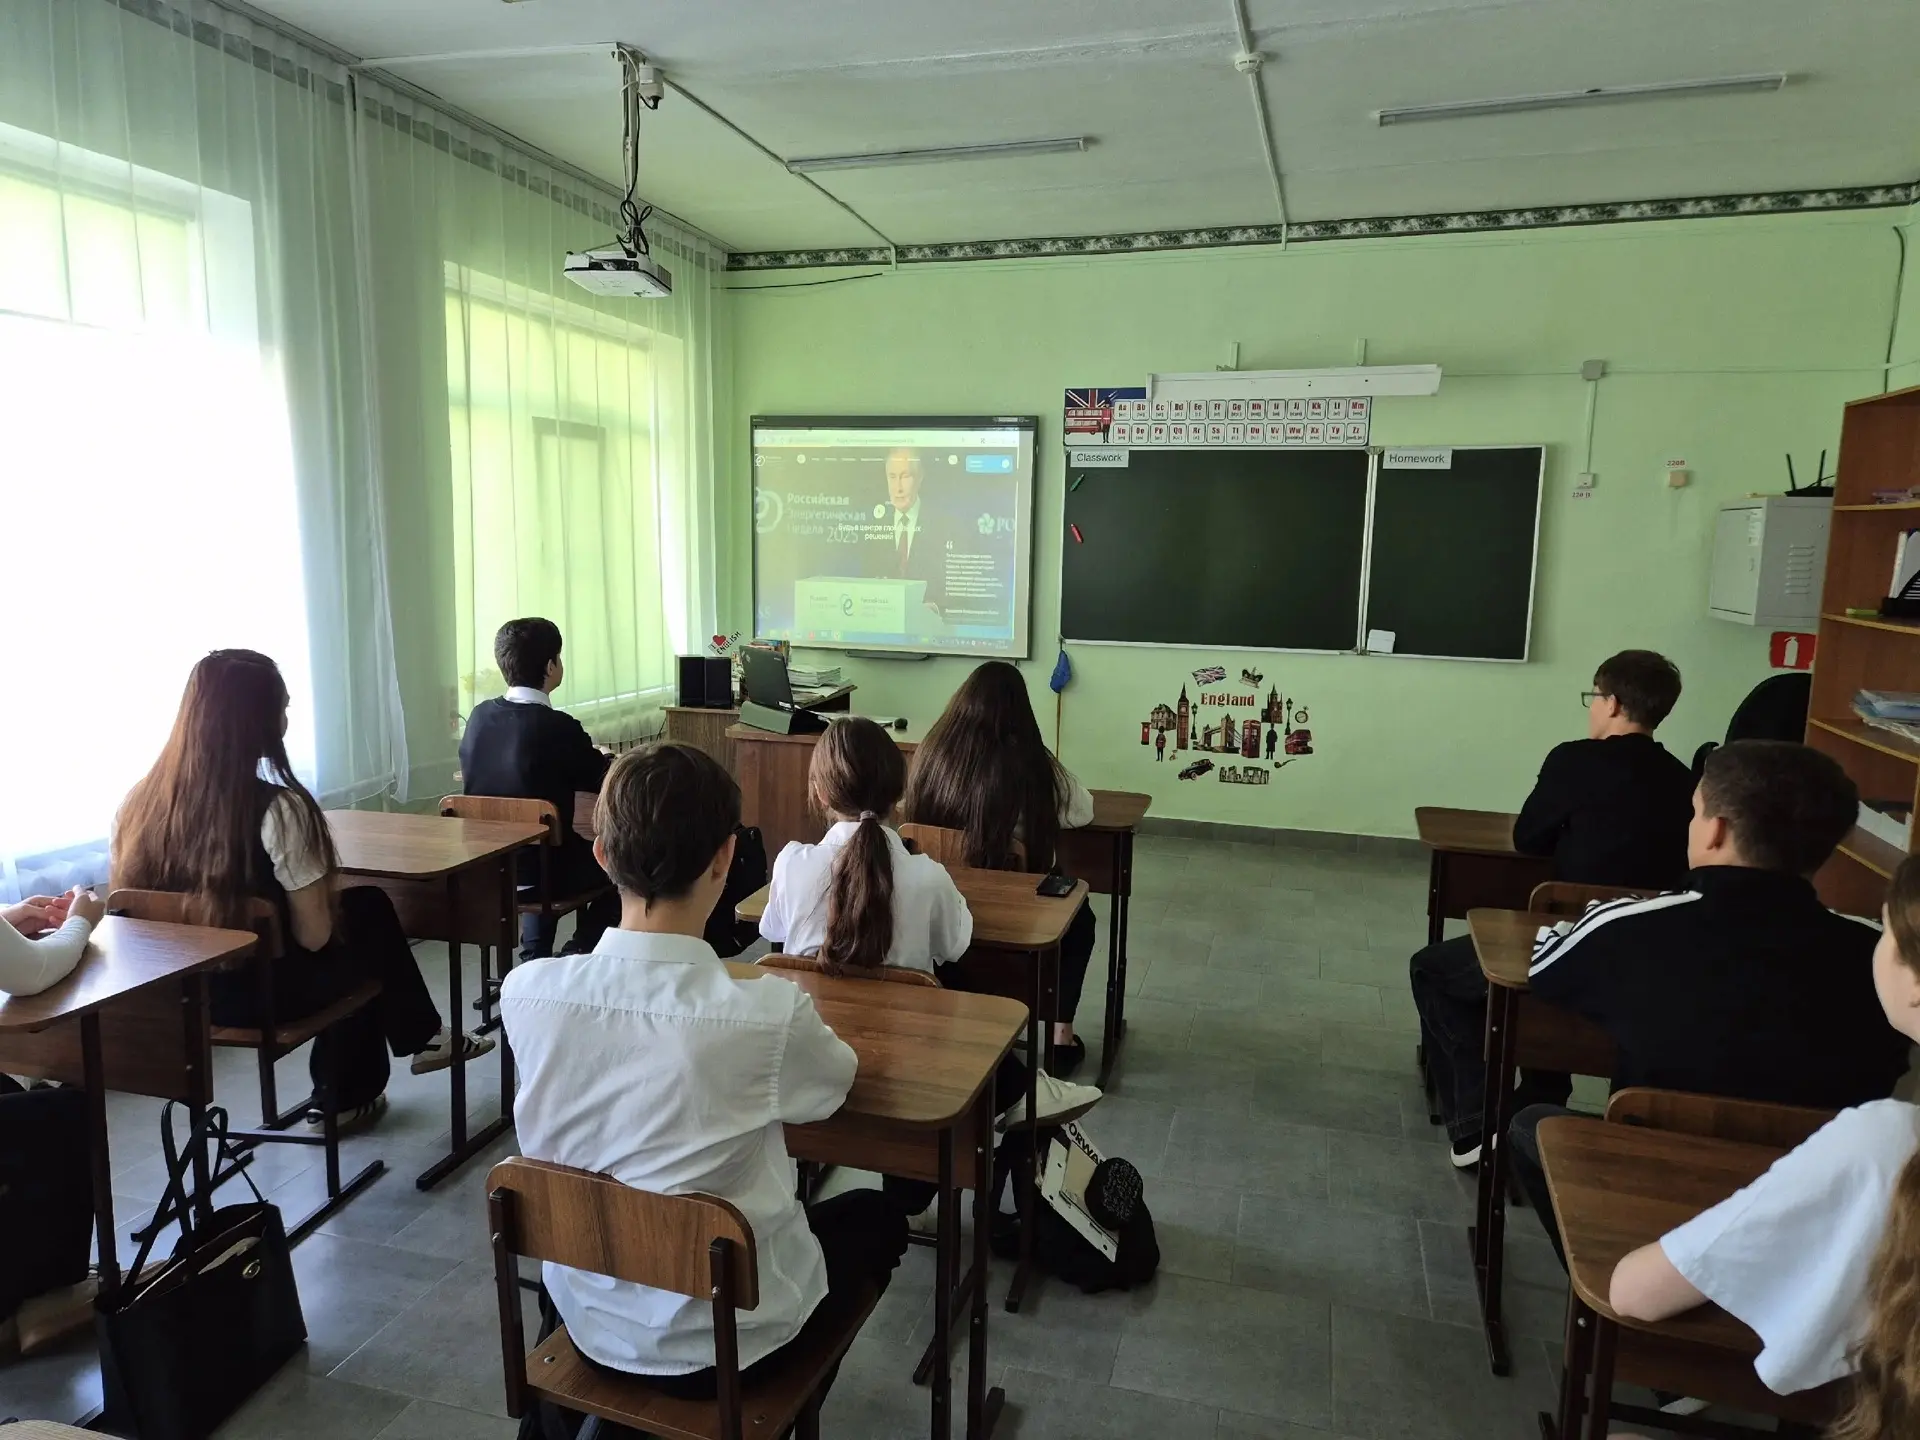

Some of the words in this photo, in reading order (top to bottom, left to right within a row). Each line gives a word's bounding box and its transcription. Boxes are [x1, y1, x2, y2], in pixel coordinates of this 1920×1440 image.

[1076, 453, 1122, 462] Classwork
[1389, 453, 1445, 463] Homework
[787, 493, 850, 506] Российская
[826, 526, 859, 544] 2025
[864, 532, 894, 541] решений
[717, 631, 742, 655] ENGLISH
[1200, 692, 1255, 708] England
